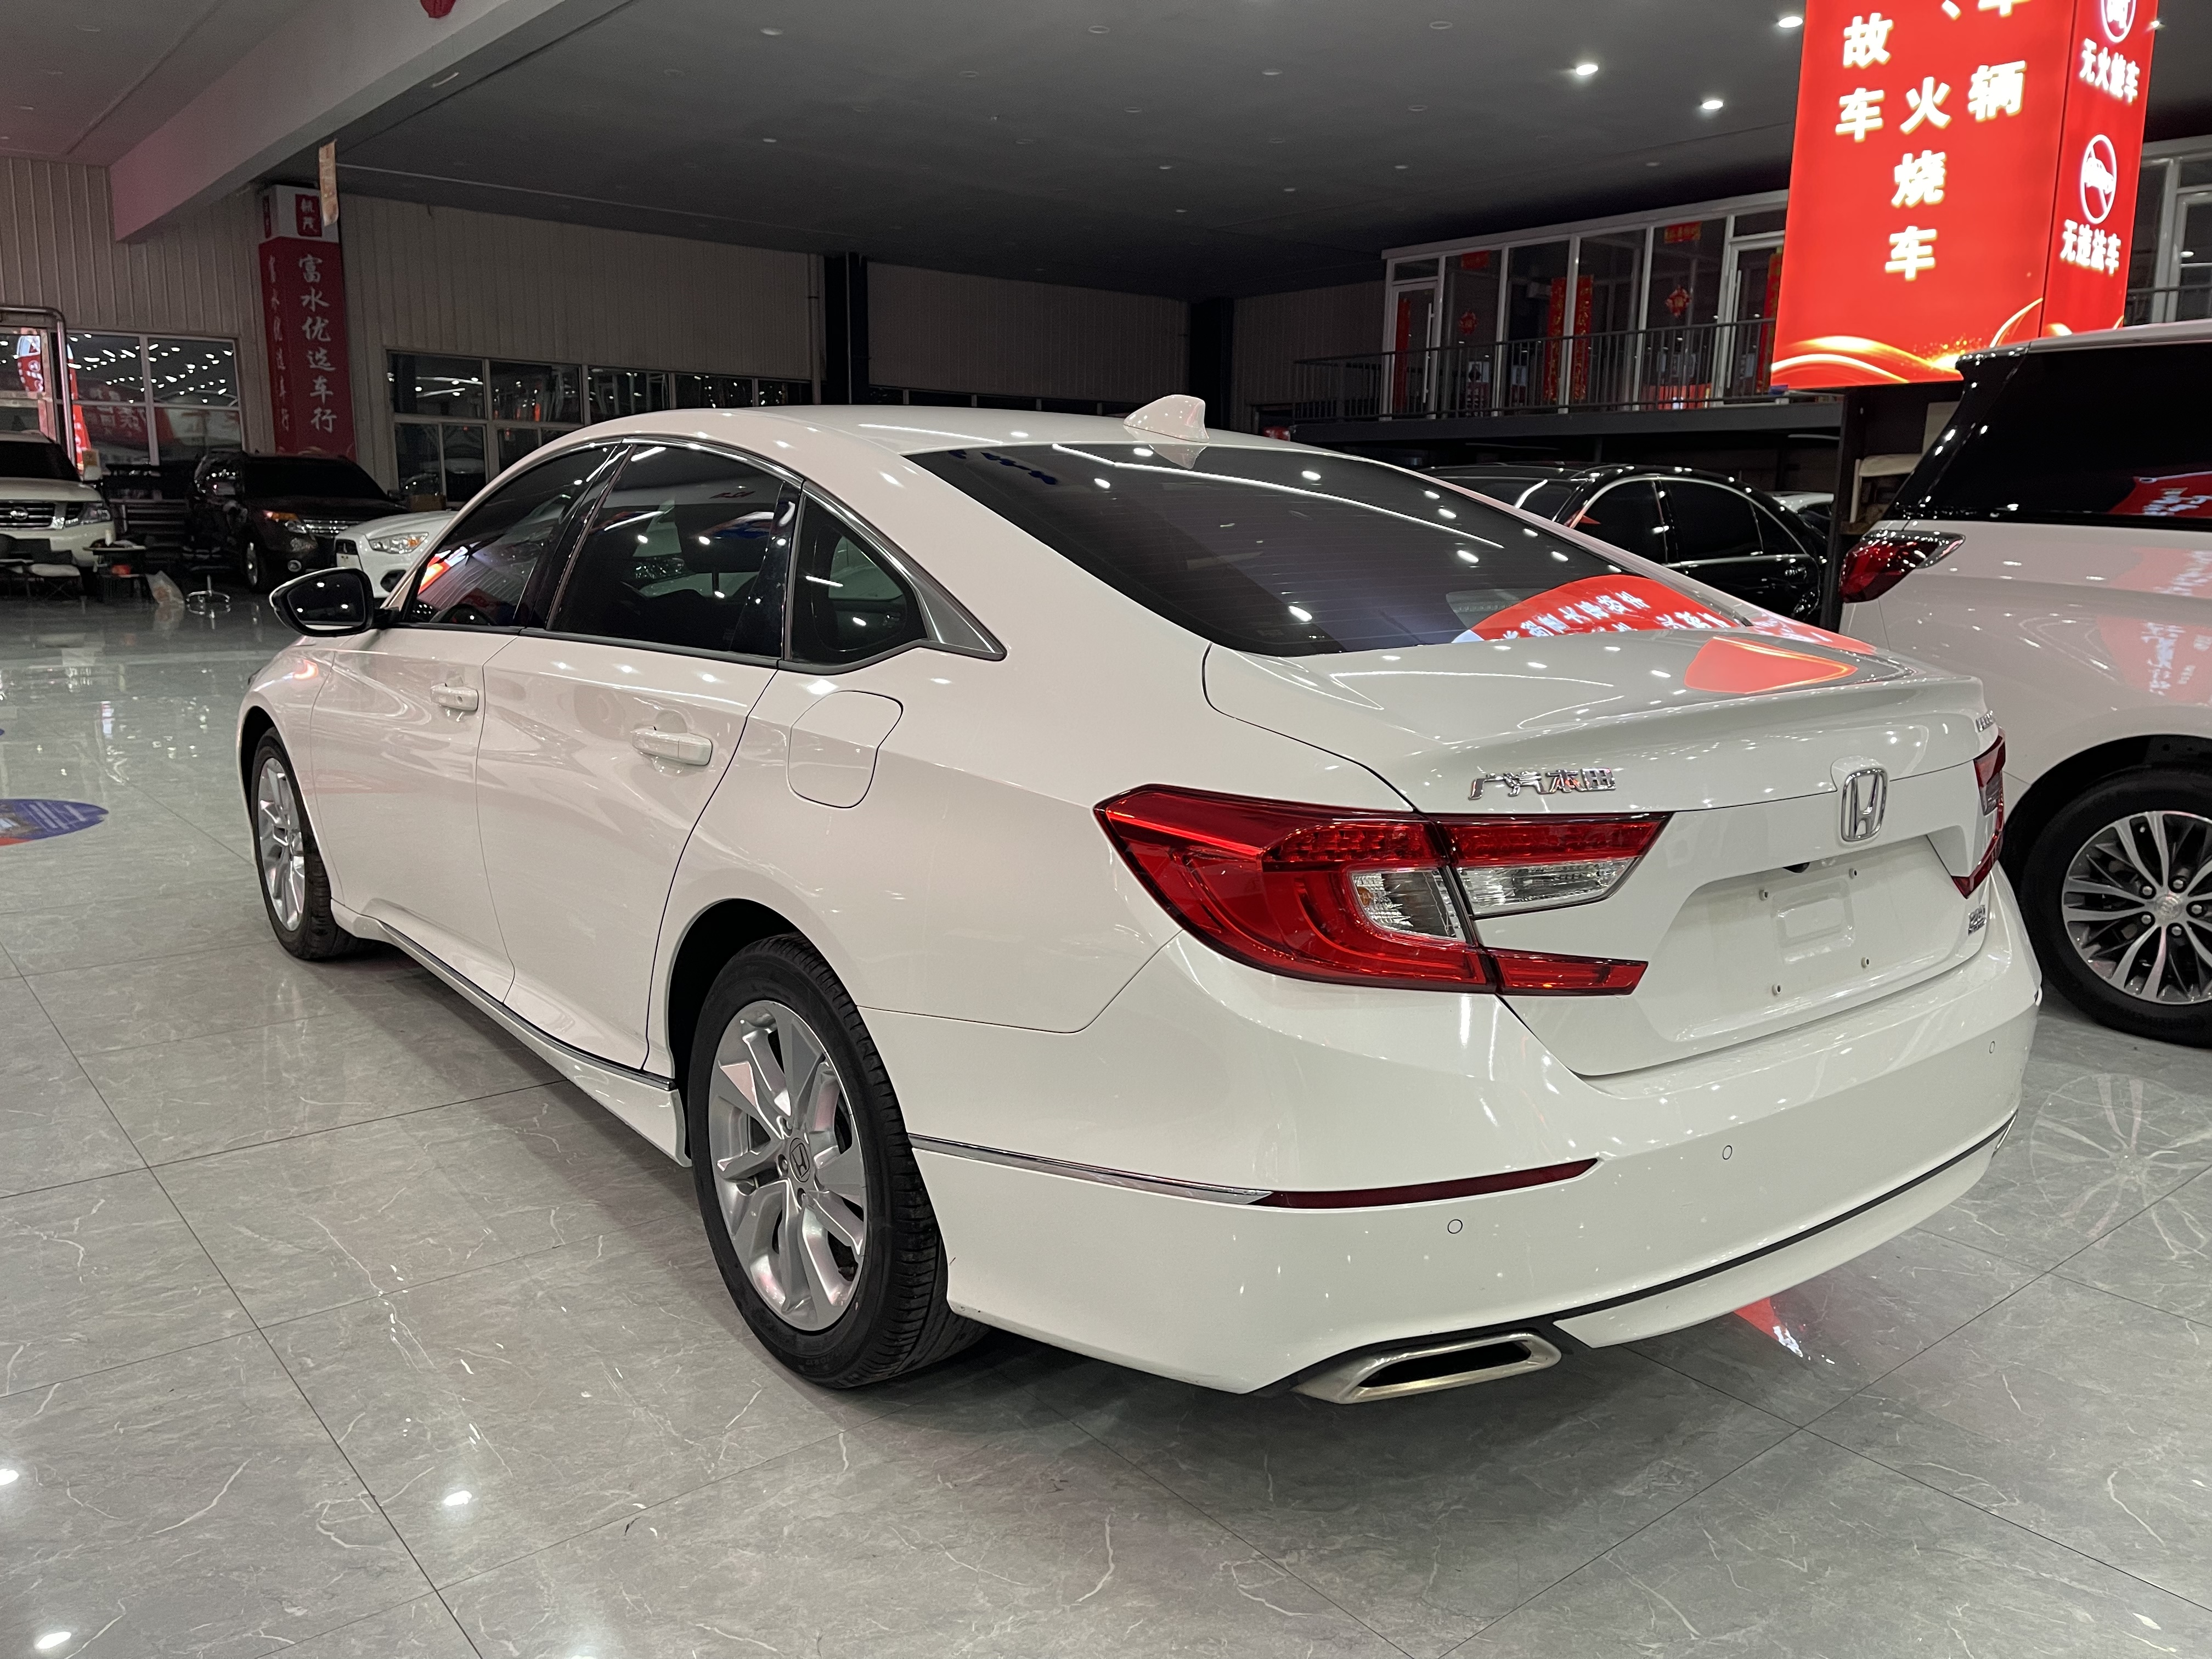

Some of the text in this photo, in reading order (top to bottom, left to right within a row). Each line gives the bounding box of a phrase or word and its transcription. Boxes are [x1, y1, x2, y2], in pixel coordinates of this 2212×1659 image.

[1835, 12, 1893, 143] 故车
[298, 253, 337, 433] 富水优选车行
[1468, 768, 1617, 800] 广汽本田
